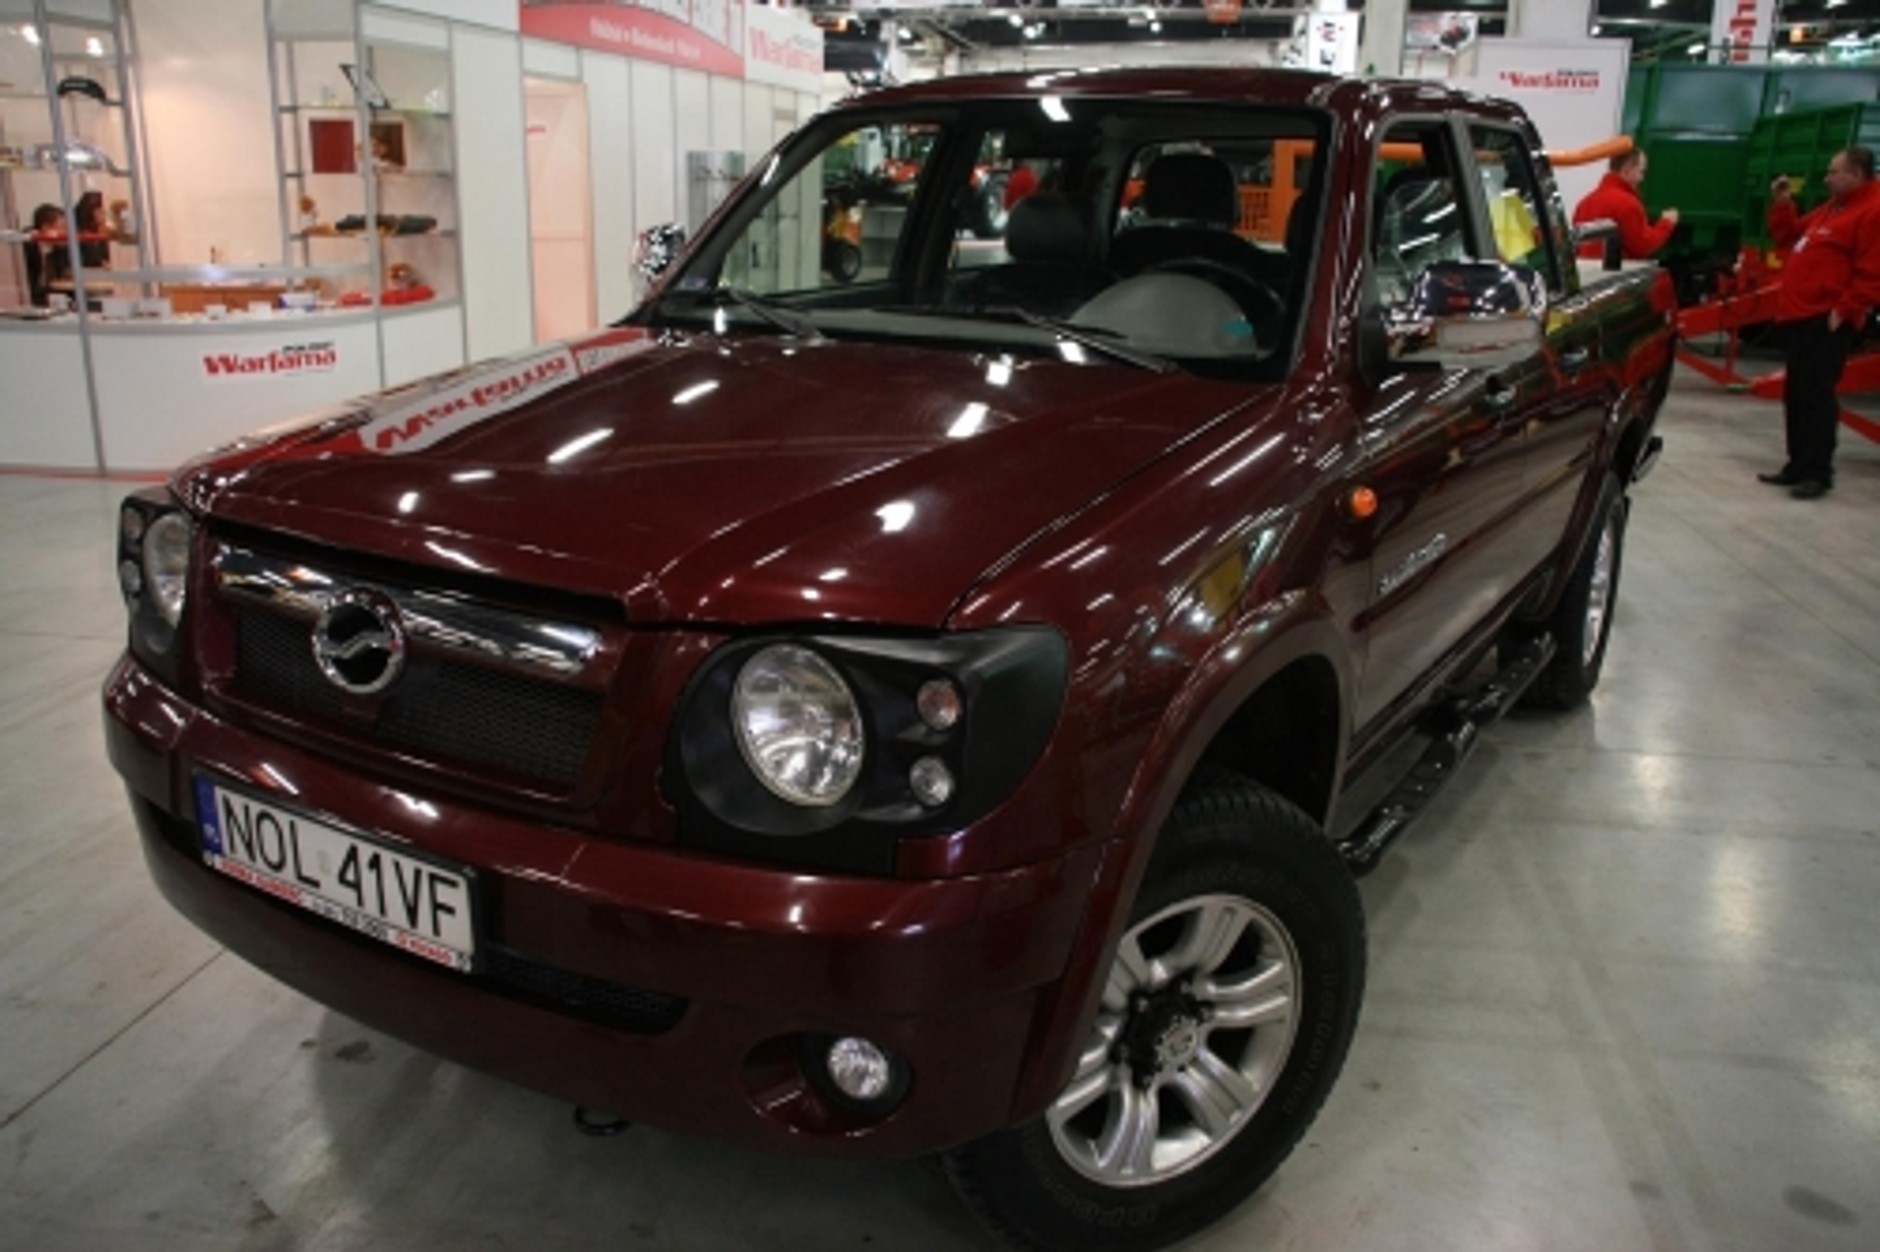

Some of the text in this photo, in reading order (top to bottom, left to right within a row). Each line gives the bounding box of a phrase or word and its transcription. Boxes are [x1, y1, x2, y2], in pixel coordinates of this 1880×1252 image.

[203, 350, 338, 375] Warfama
[222, 793, 321, 889] NOL
[338, 843, 460, 938] 41VF
